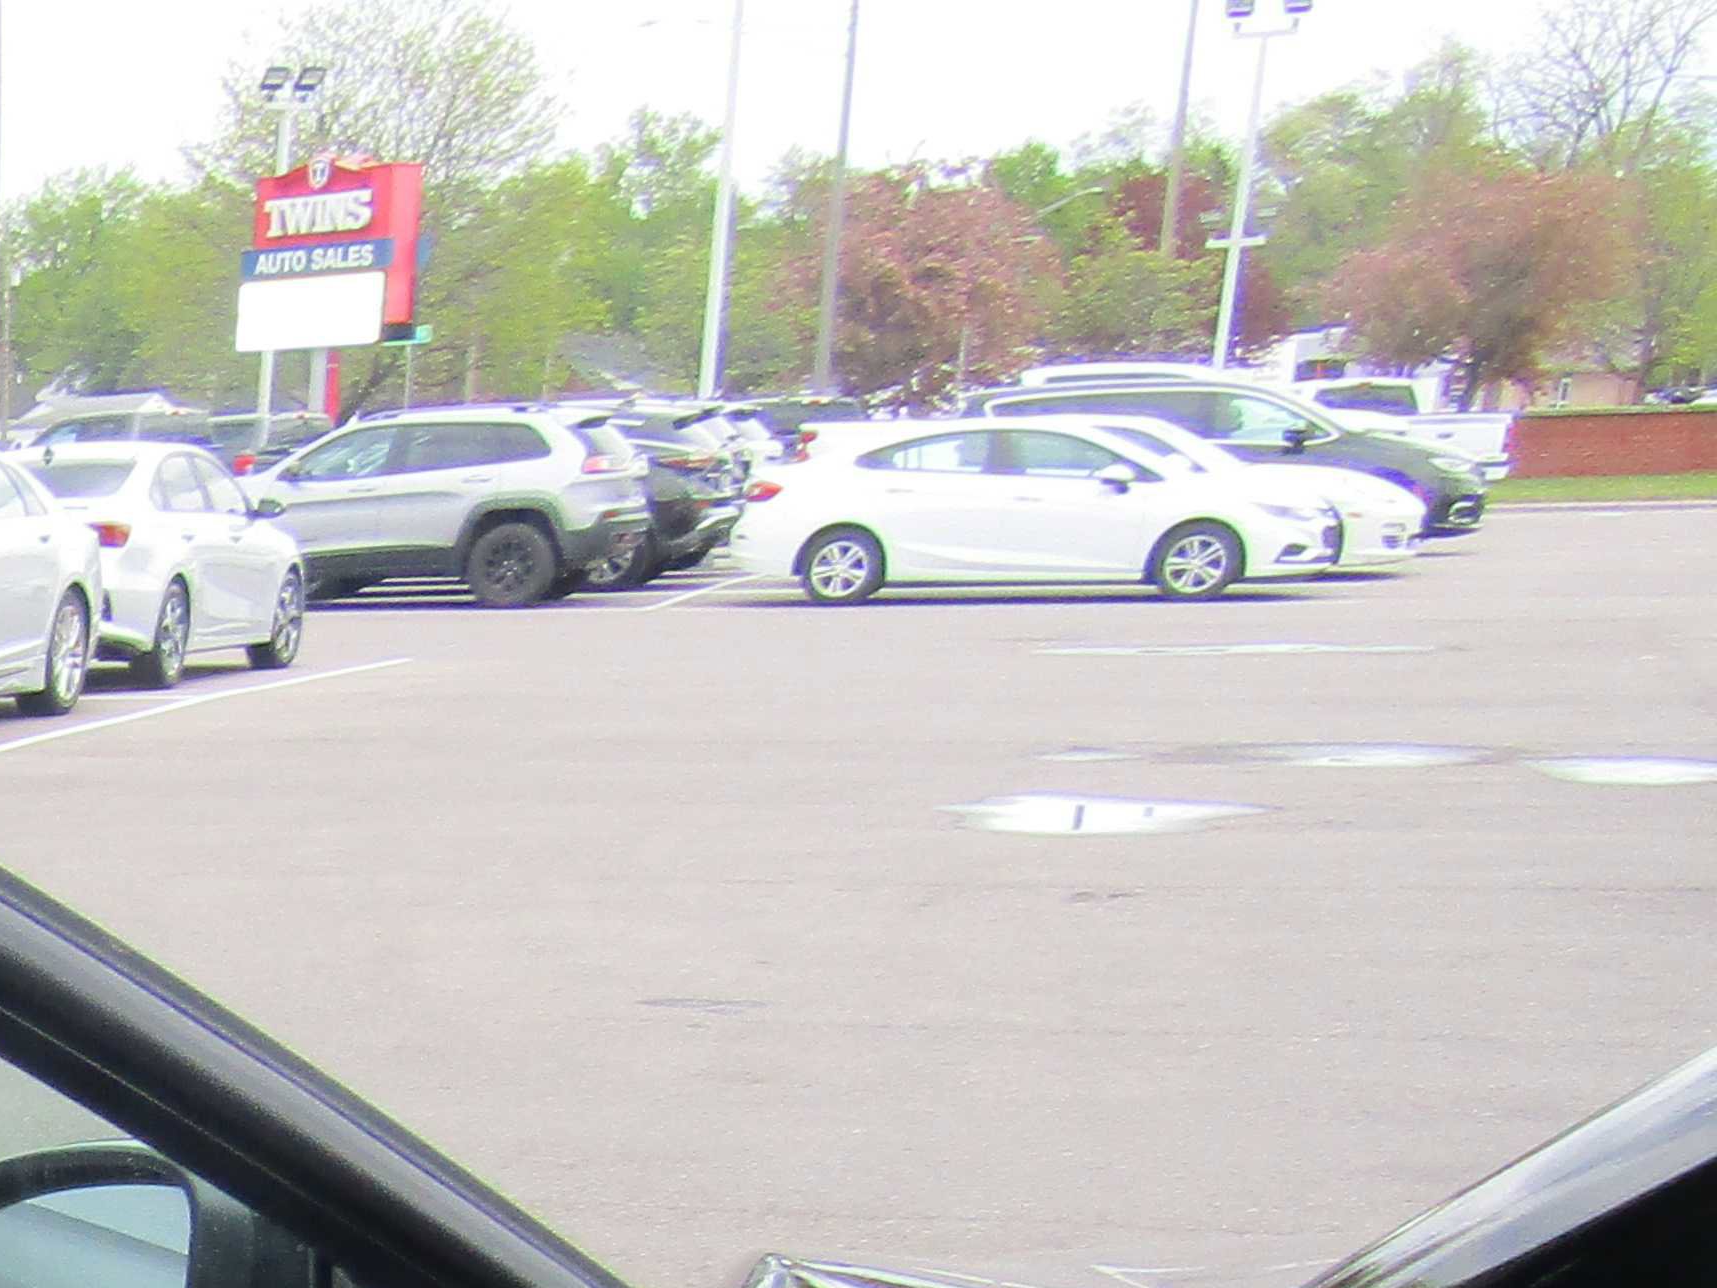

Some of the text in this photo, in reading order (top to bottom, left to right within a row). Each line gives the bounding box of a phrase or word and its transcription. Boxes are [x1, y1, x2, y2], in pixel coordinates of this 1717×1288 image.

[265, 189, 373, 238] TWINS
[255, 245, 373, 275] AUTO SALES
